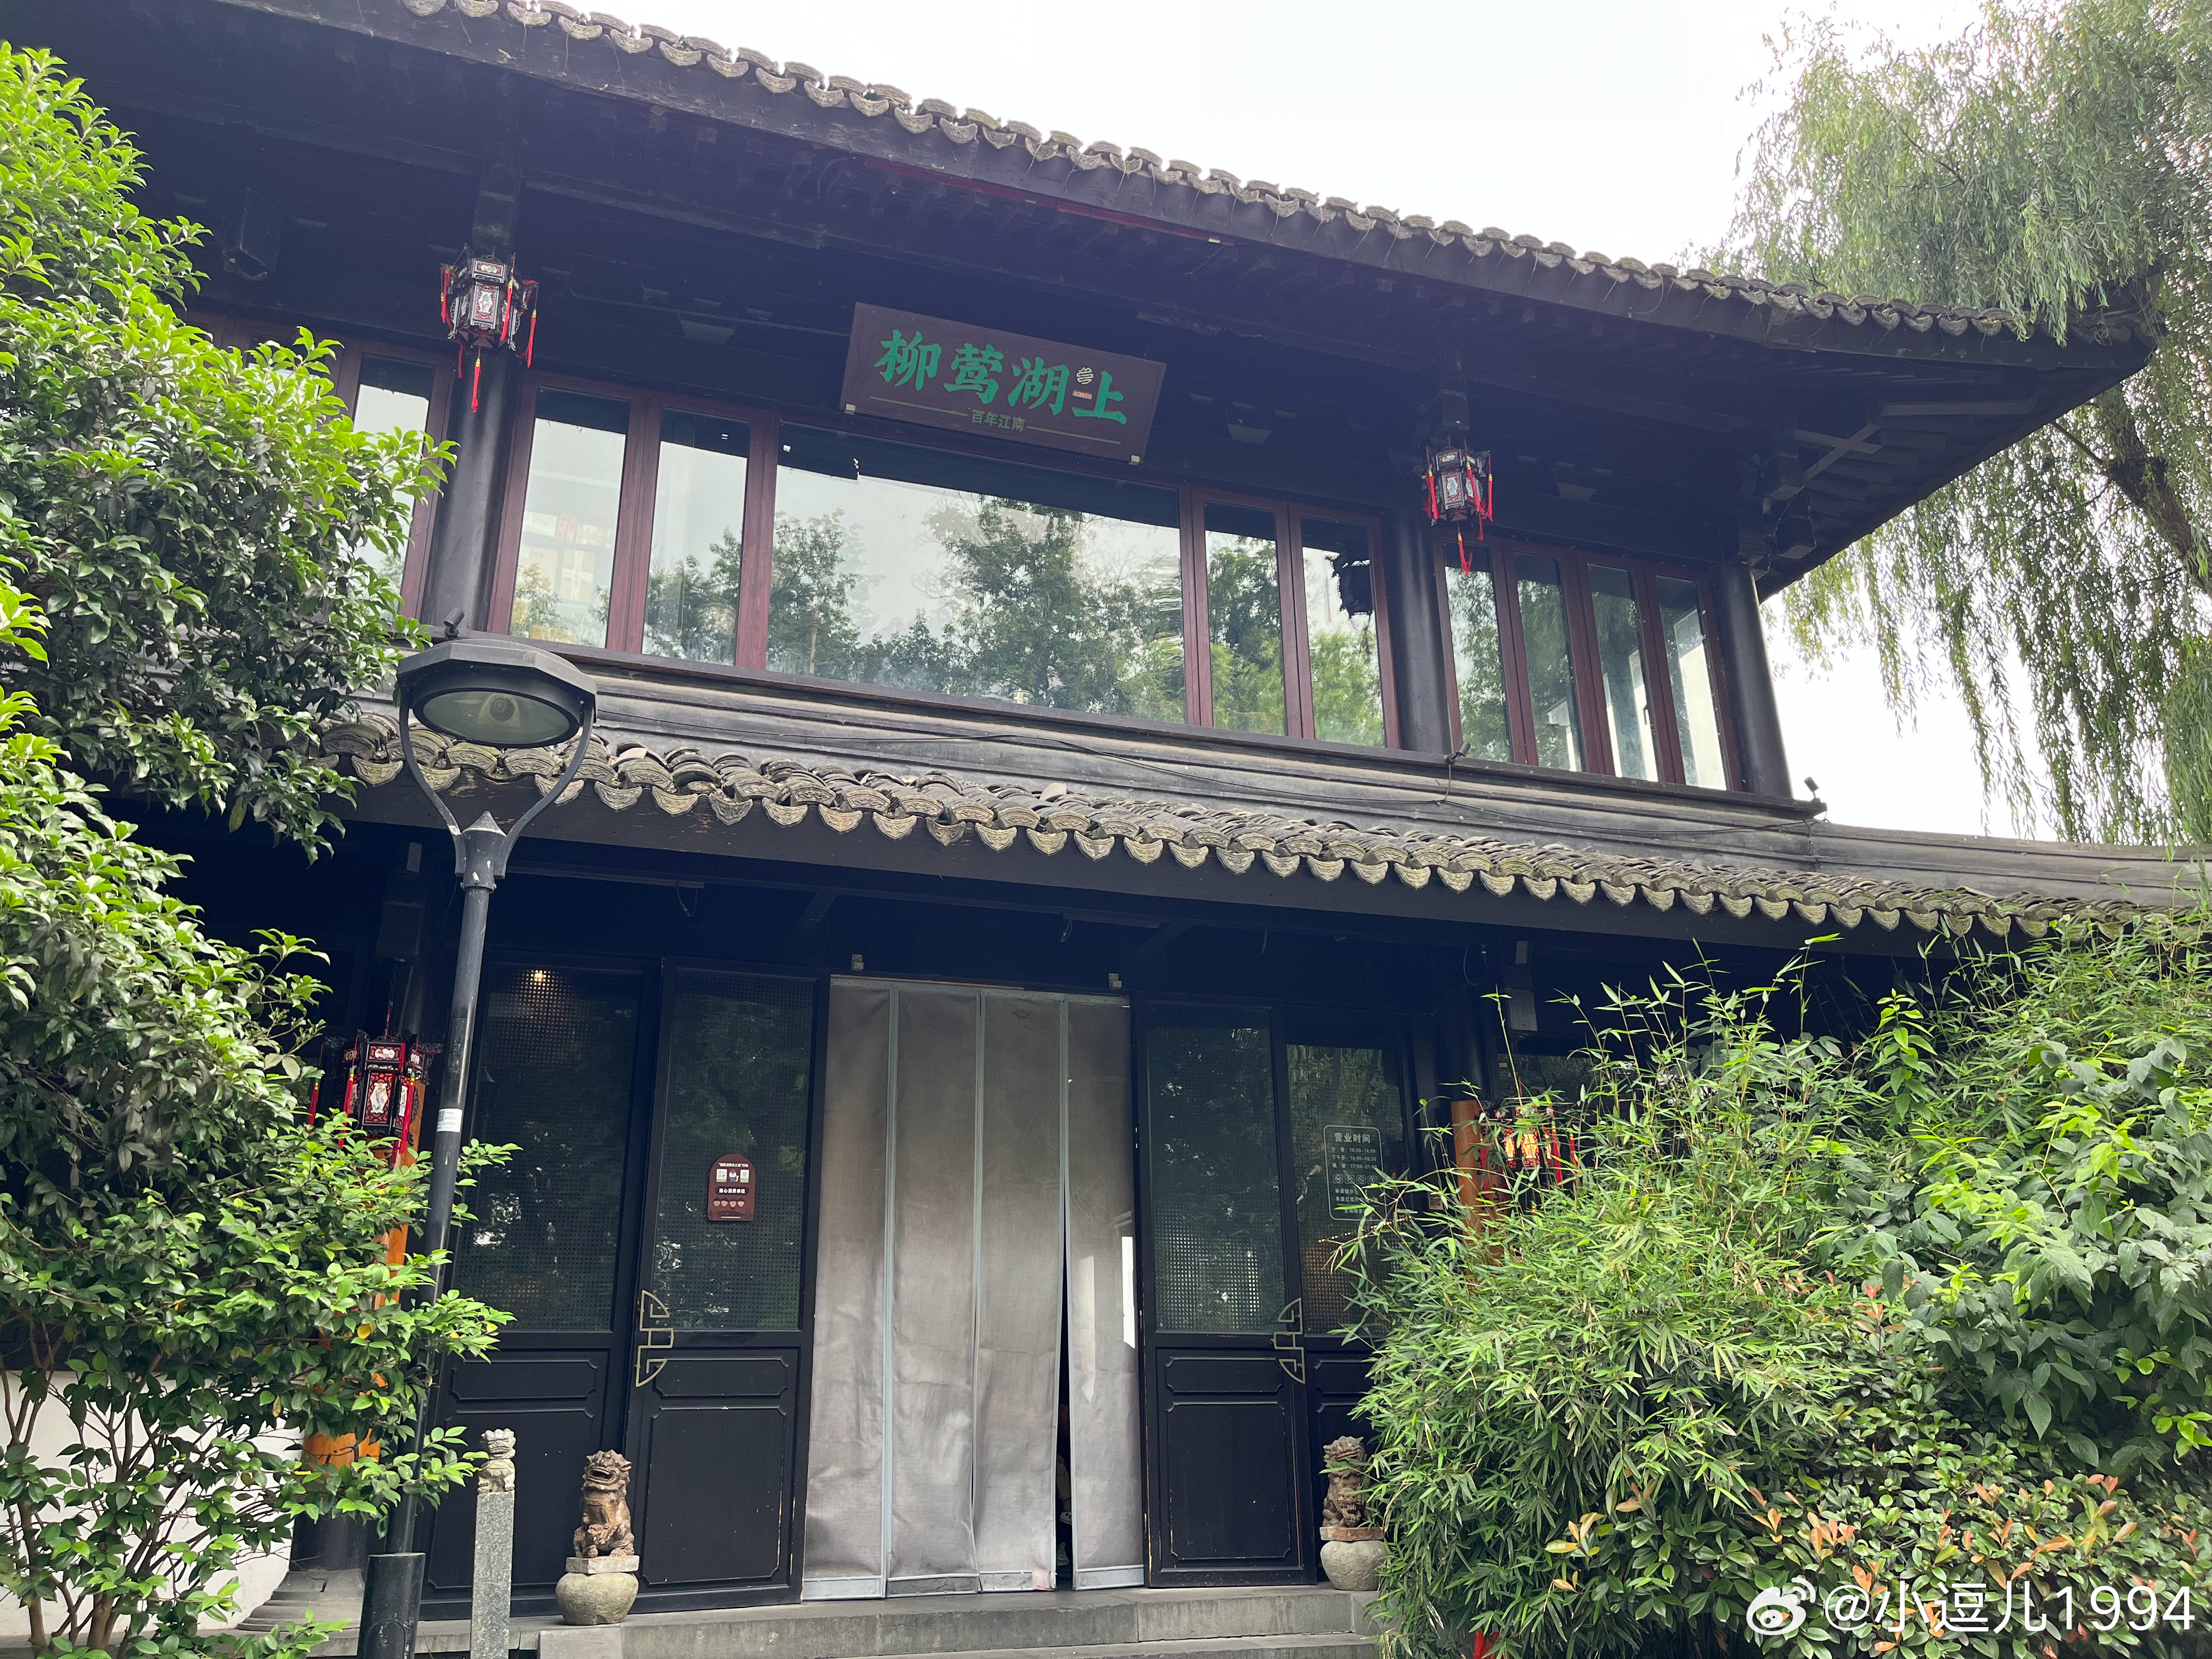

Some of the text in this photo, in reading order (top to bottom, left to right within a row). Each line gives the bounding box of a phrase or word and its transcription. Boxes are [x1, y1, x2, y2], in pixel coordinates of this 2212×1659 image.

[874, 330, 1127, 424] 柳莺湖上
[972, 408, 1025, 432] 百年江南
[1334, 1132, 1371, 1143] 营业时间
